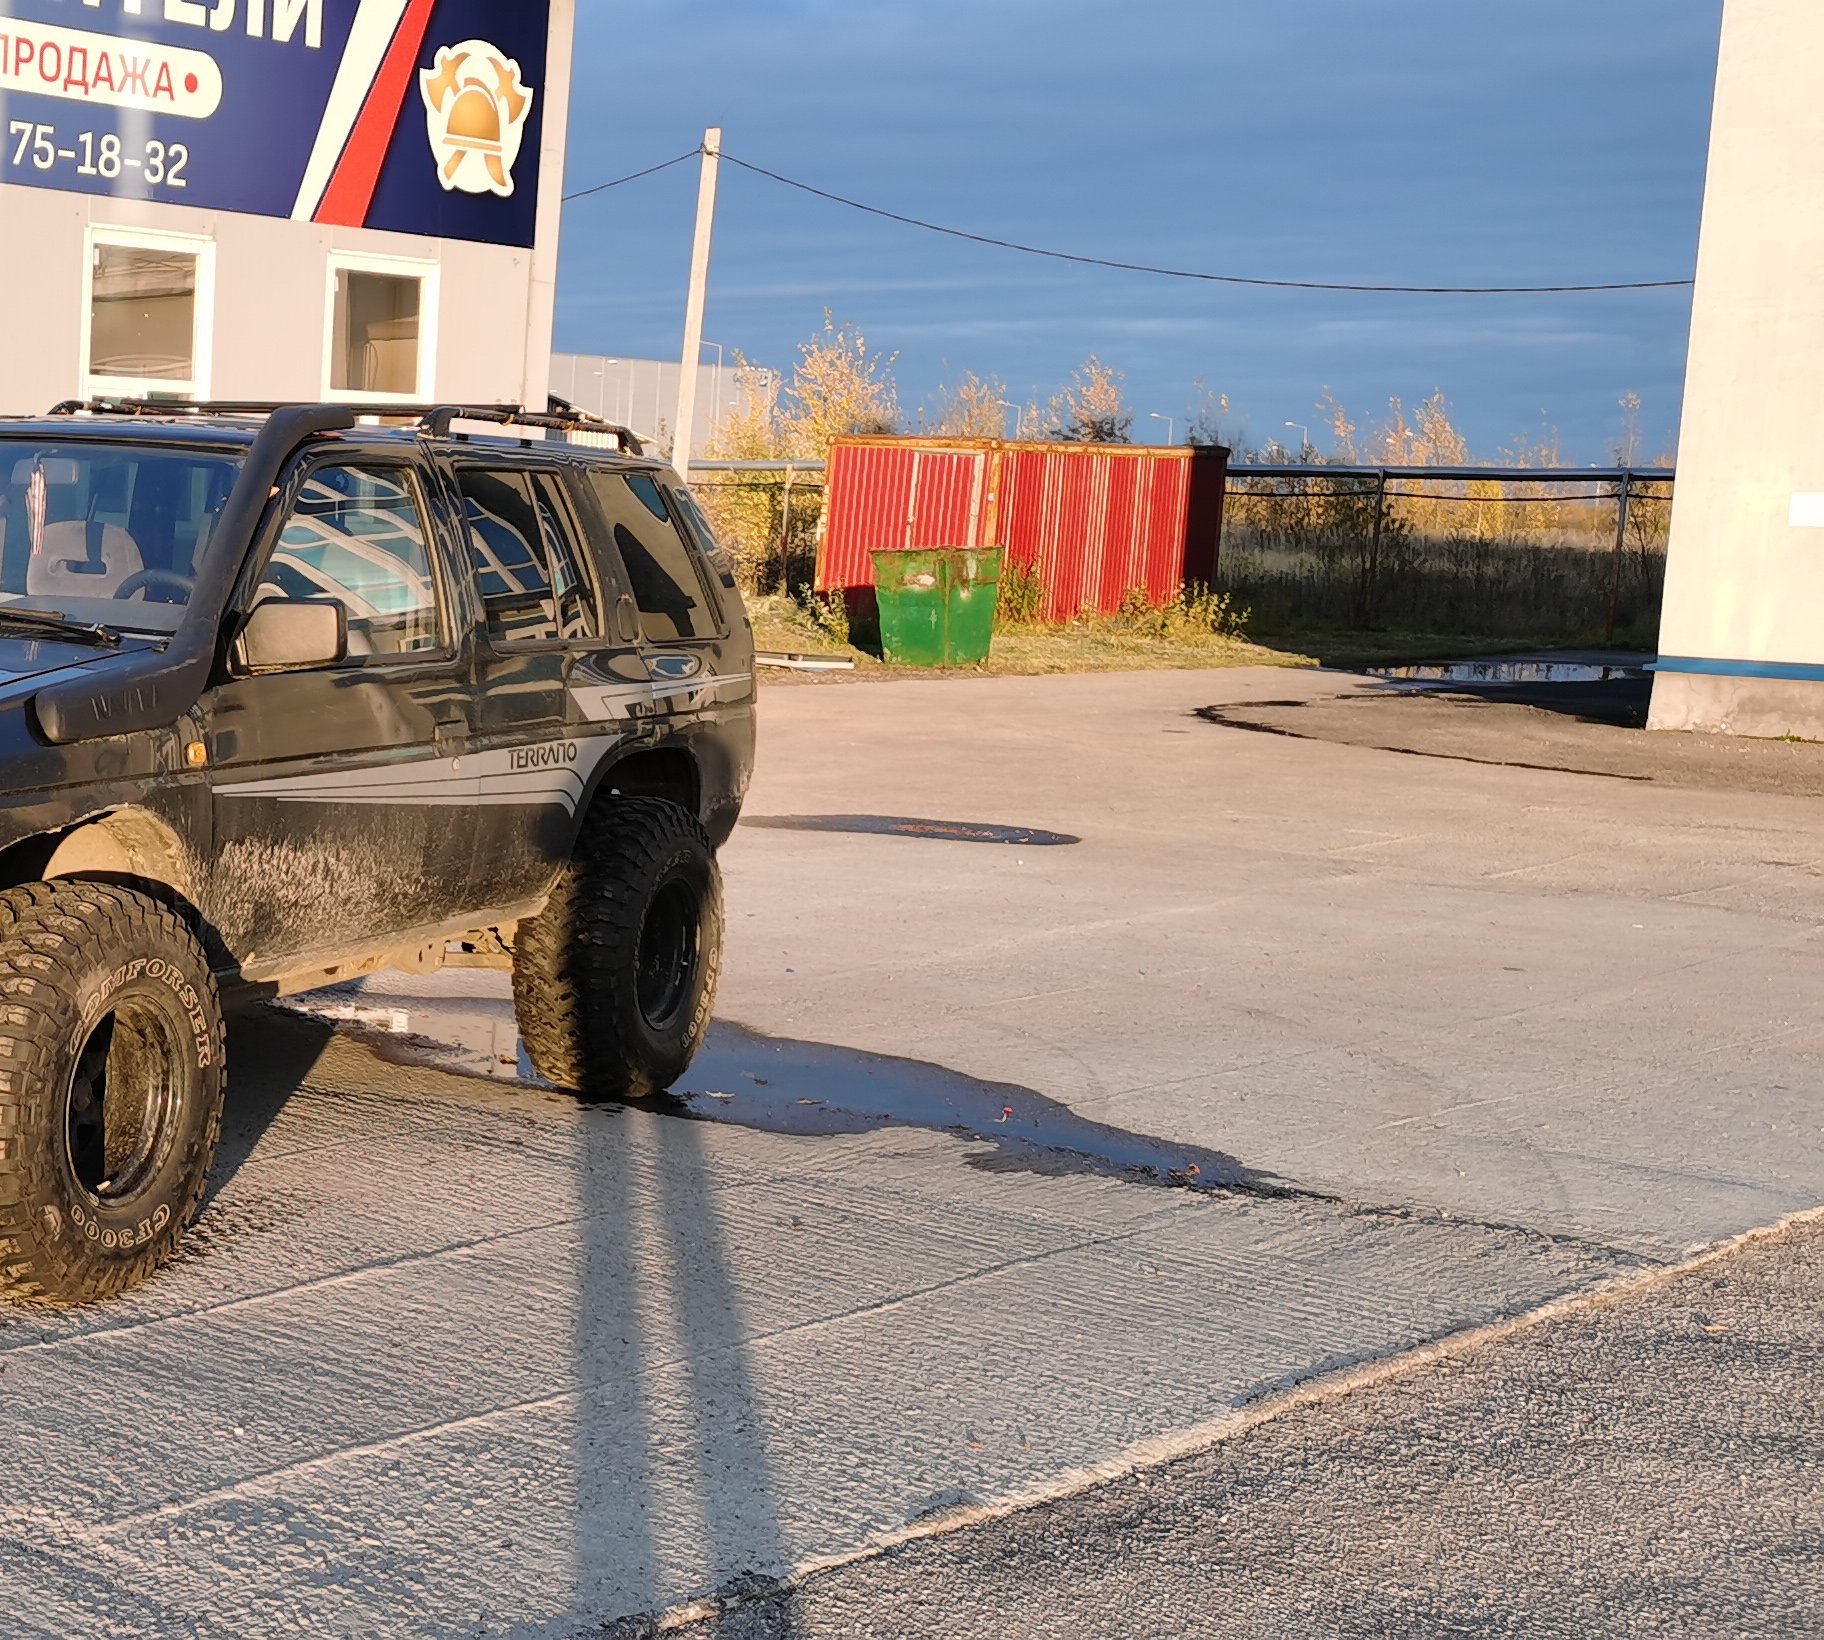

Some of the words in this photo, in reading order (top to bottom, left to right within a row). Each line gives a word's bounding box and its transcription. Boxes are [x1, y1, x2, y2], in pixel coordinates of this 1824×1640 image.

[8, 120, 190, 188] 75-18-32
[507, 742, 578, 770] TERRANO
[69, 957, 212, 1069] COMFORSER
[70, 1203, 171, 1249] CF3000
